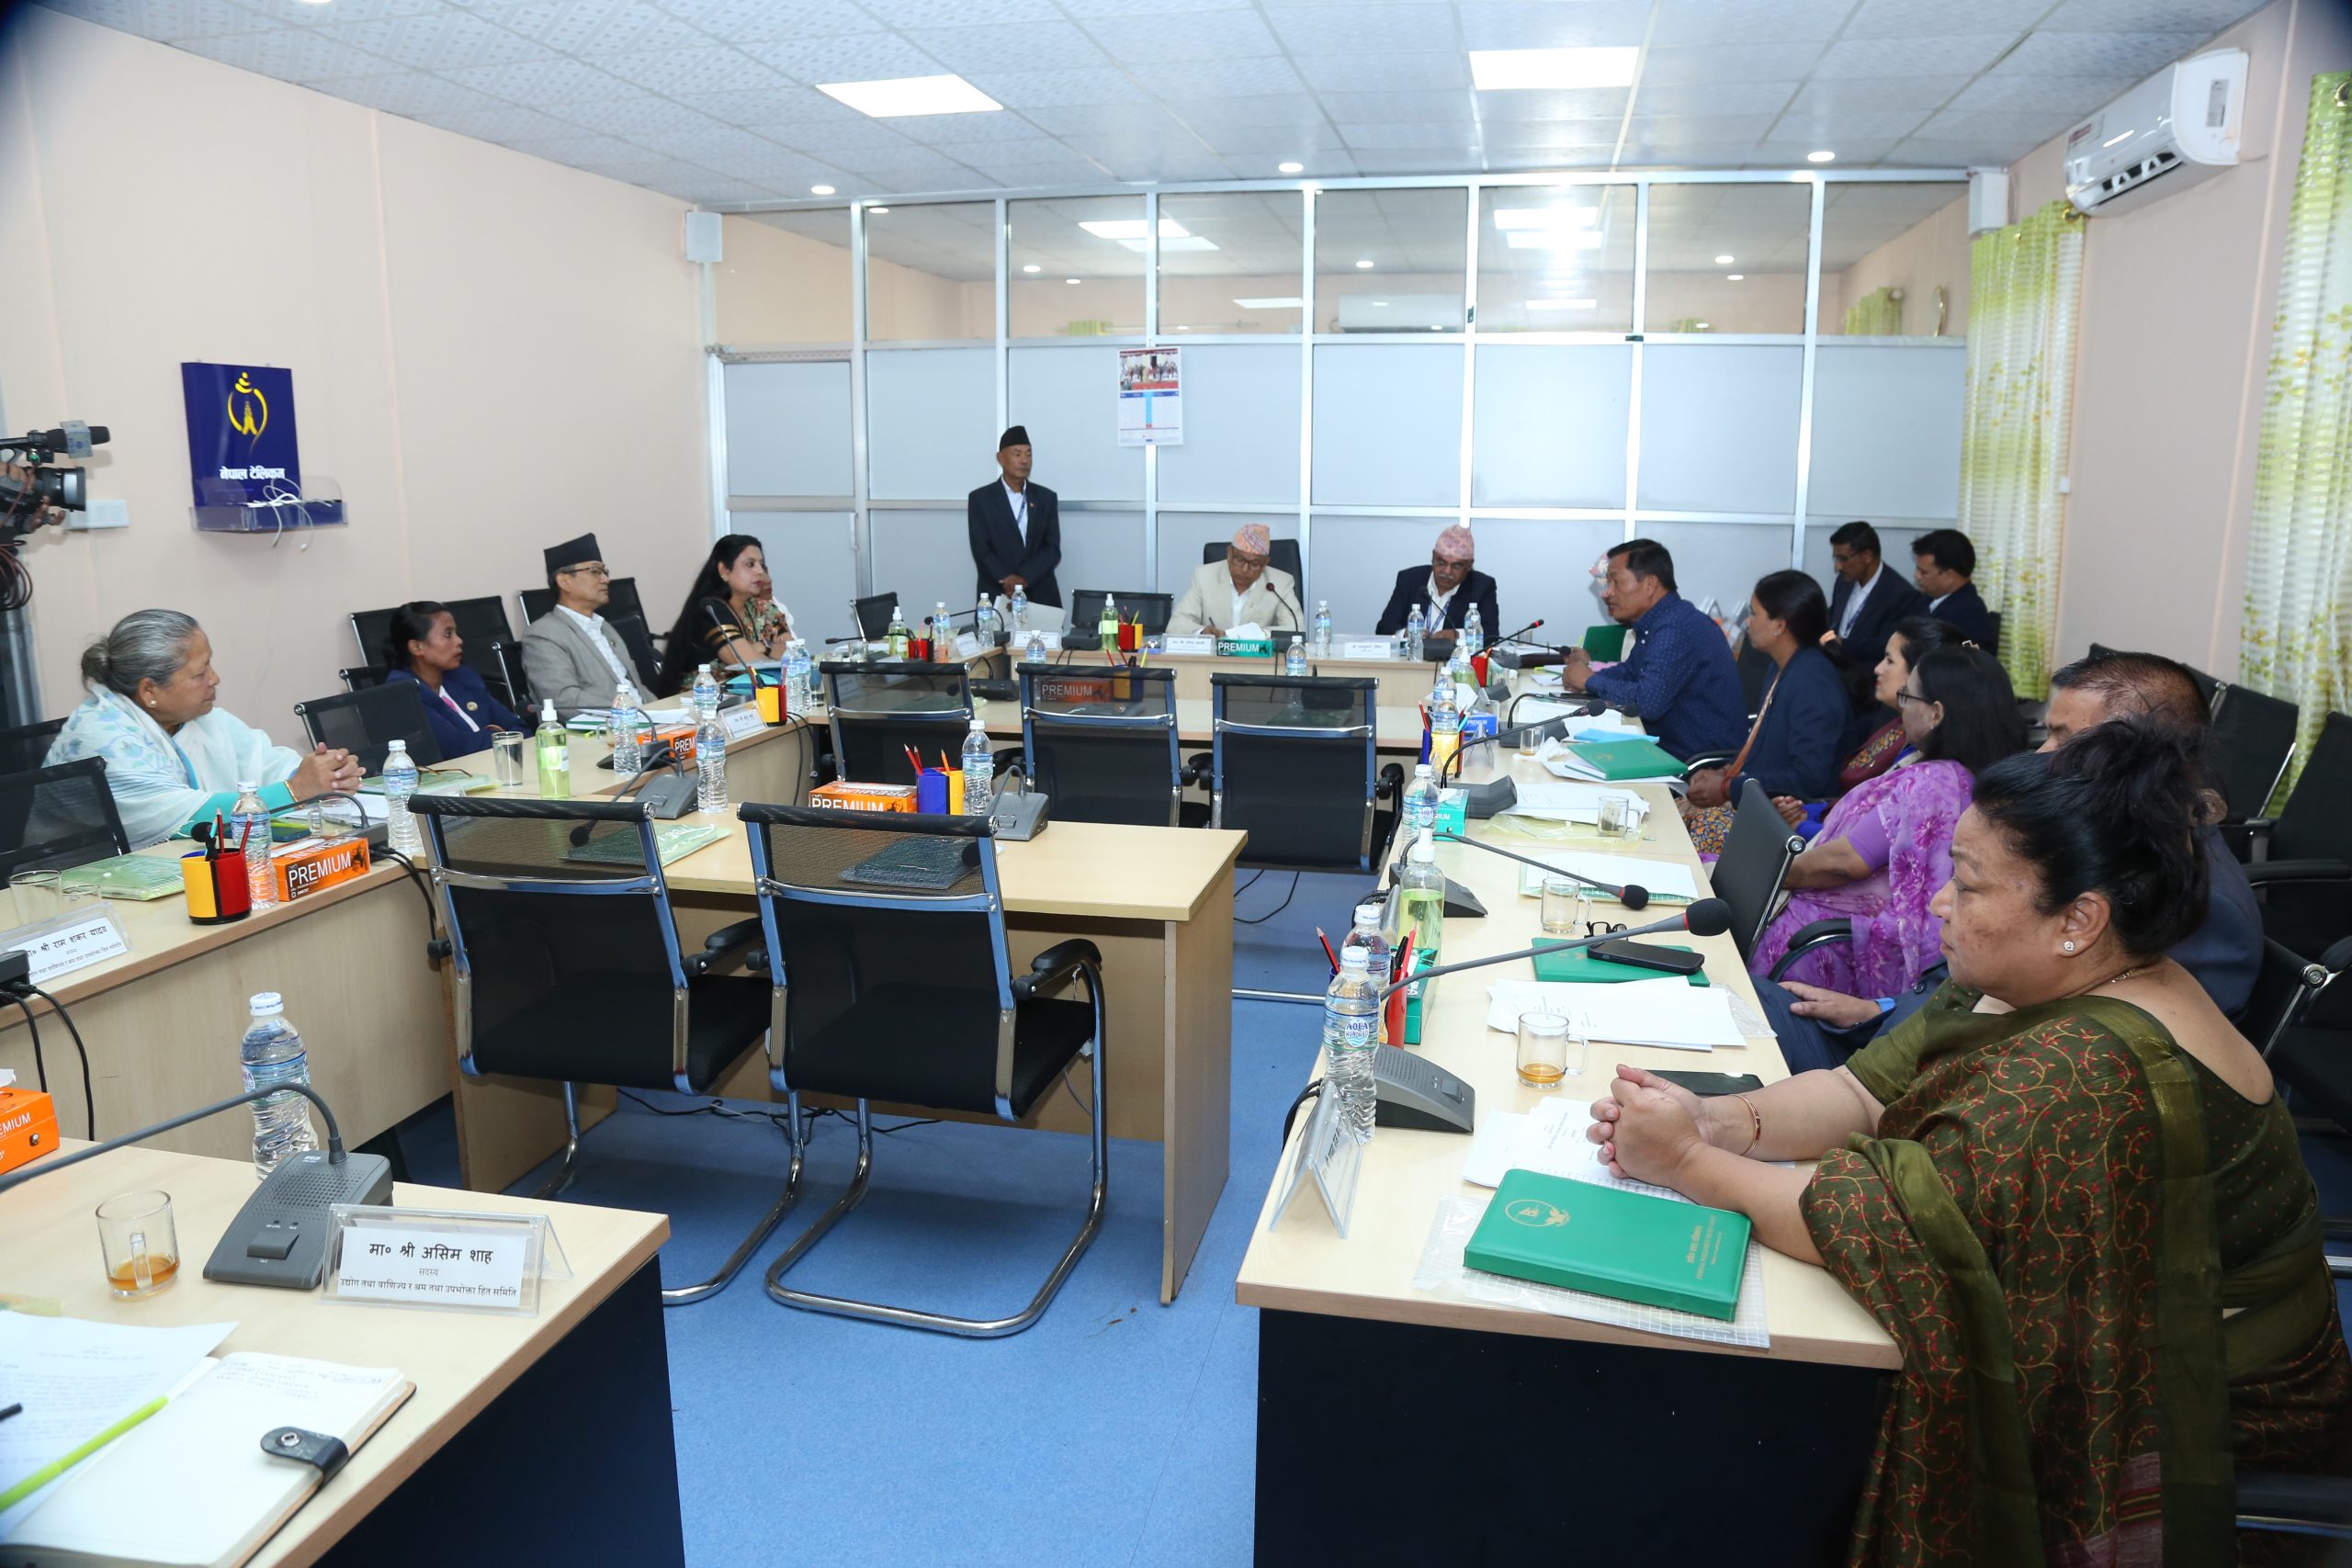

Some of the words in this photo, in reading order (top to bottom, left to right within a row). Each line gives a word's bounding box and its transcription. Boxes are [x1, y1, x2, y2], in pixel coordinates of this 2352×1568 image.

[220, 466, 248, 479] नेपाल
[1218, 642, 1260, 653] PREMIUM
[1042, 684, 1092, 696] PREMIUM
[674, 737, 695, 752] PREM
[288, 851, 352, 888] PREMIUM
[41, 942, 51, 952] श्री
[53, 939, 66, 949] राम
[89, 926, 107, 936] यादव
[369, 1243, 391, 1256] मा०
[400, 1242, 415, 1258] श्री
[421, 1243, 462, 1261] असिम
[469, 1249, 493, 1264] शाह
[419, 1268, 439, 1276] सदस्य
[340, 1276, 360, 1287] उद्योग
[361, 1279, 376, 1288] तथा
[378, 1278, 406, 1290] वाणिज्य
[414, 1282, 427, 1292] श्रम
[429, 1284, 444, 1292] तथा
[445, 1283, 476, 1294] उपभोक्ता
[478, 1285, 492, 1296] हित
[492, 1287, 516, 1297] समिति
